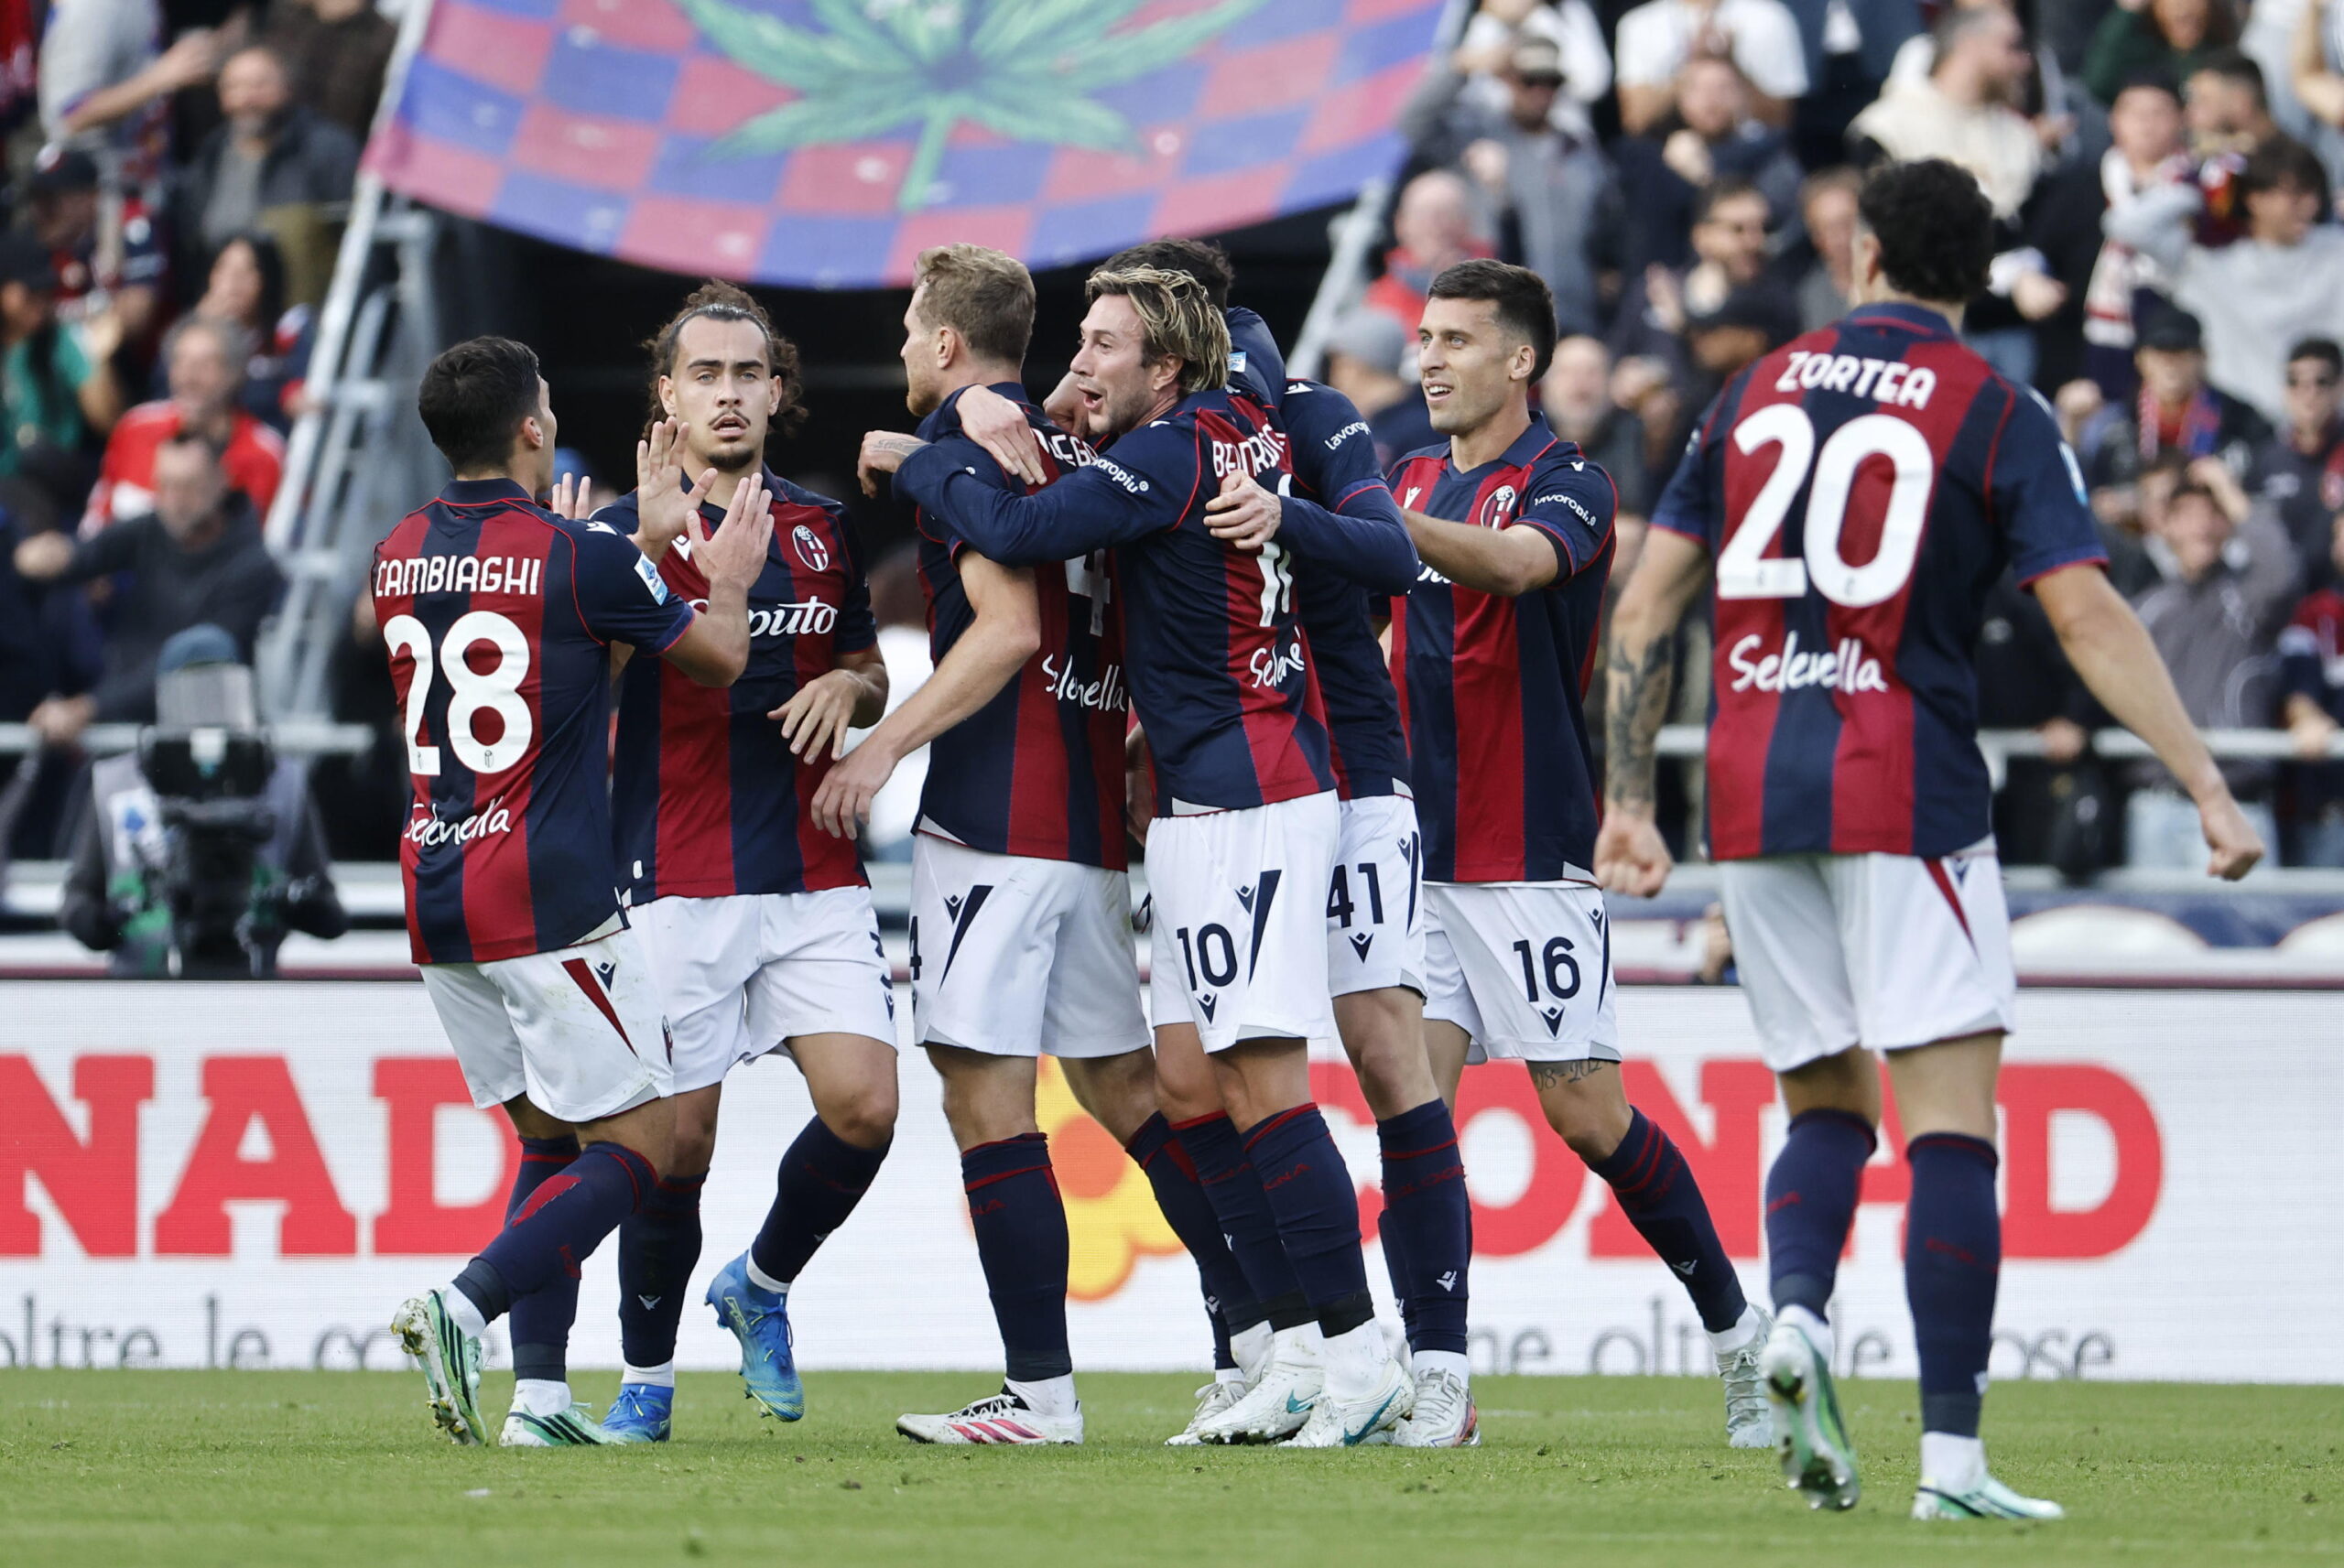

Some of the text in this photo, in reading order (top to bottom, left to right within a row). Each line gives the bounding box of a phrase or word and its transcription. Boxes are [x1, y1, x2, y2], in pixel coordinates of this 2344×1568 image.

[1774, 351, 1937, 410] ZORTEA
[1716, 403, 1934, 608] 20
[375, 555, 541, 597] CAMBIAGHI
[383, 611, 533, 776] 28
[1325, 862, 1384, 929] 41
[1176, 922, 1238, 992] 10
[1513, 935, 1581, 1003] 16
